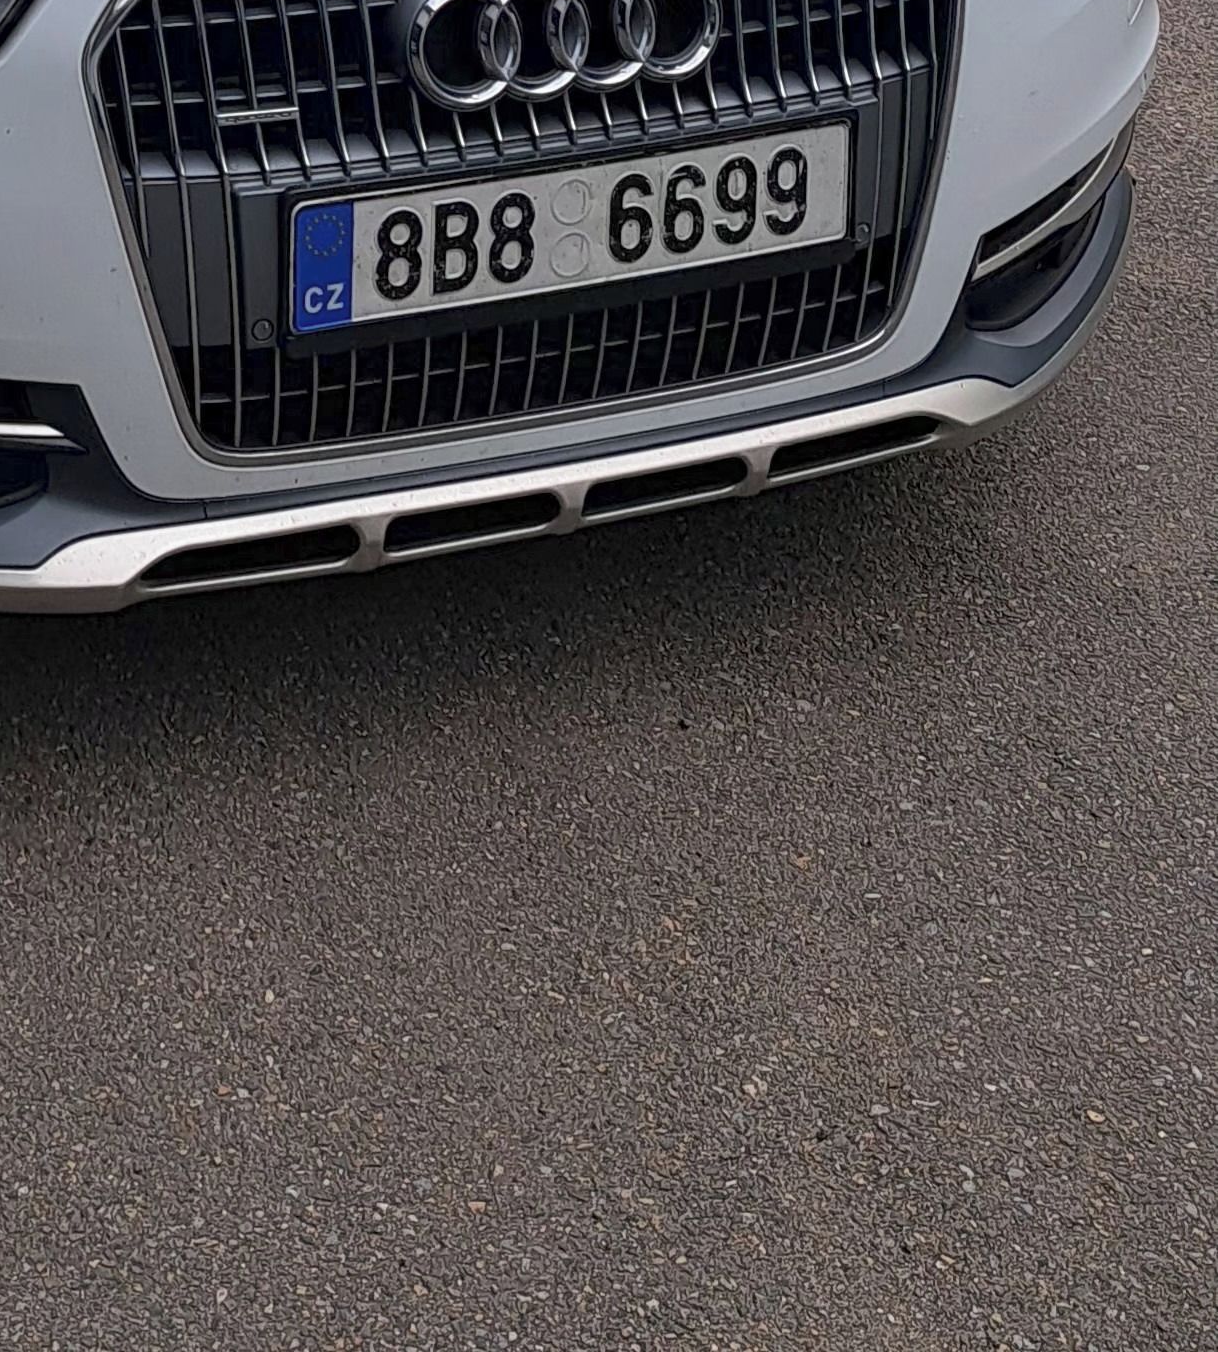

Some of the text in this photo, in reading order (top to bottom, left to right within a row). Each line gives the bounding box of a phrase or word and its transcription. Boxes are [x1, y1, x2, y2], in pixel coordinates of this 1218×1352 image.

[304, 146, 809, 315] CZ 8B8 6699
